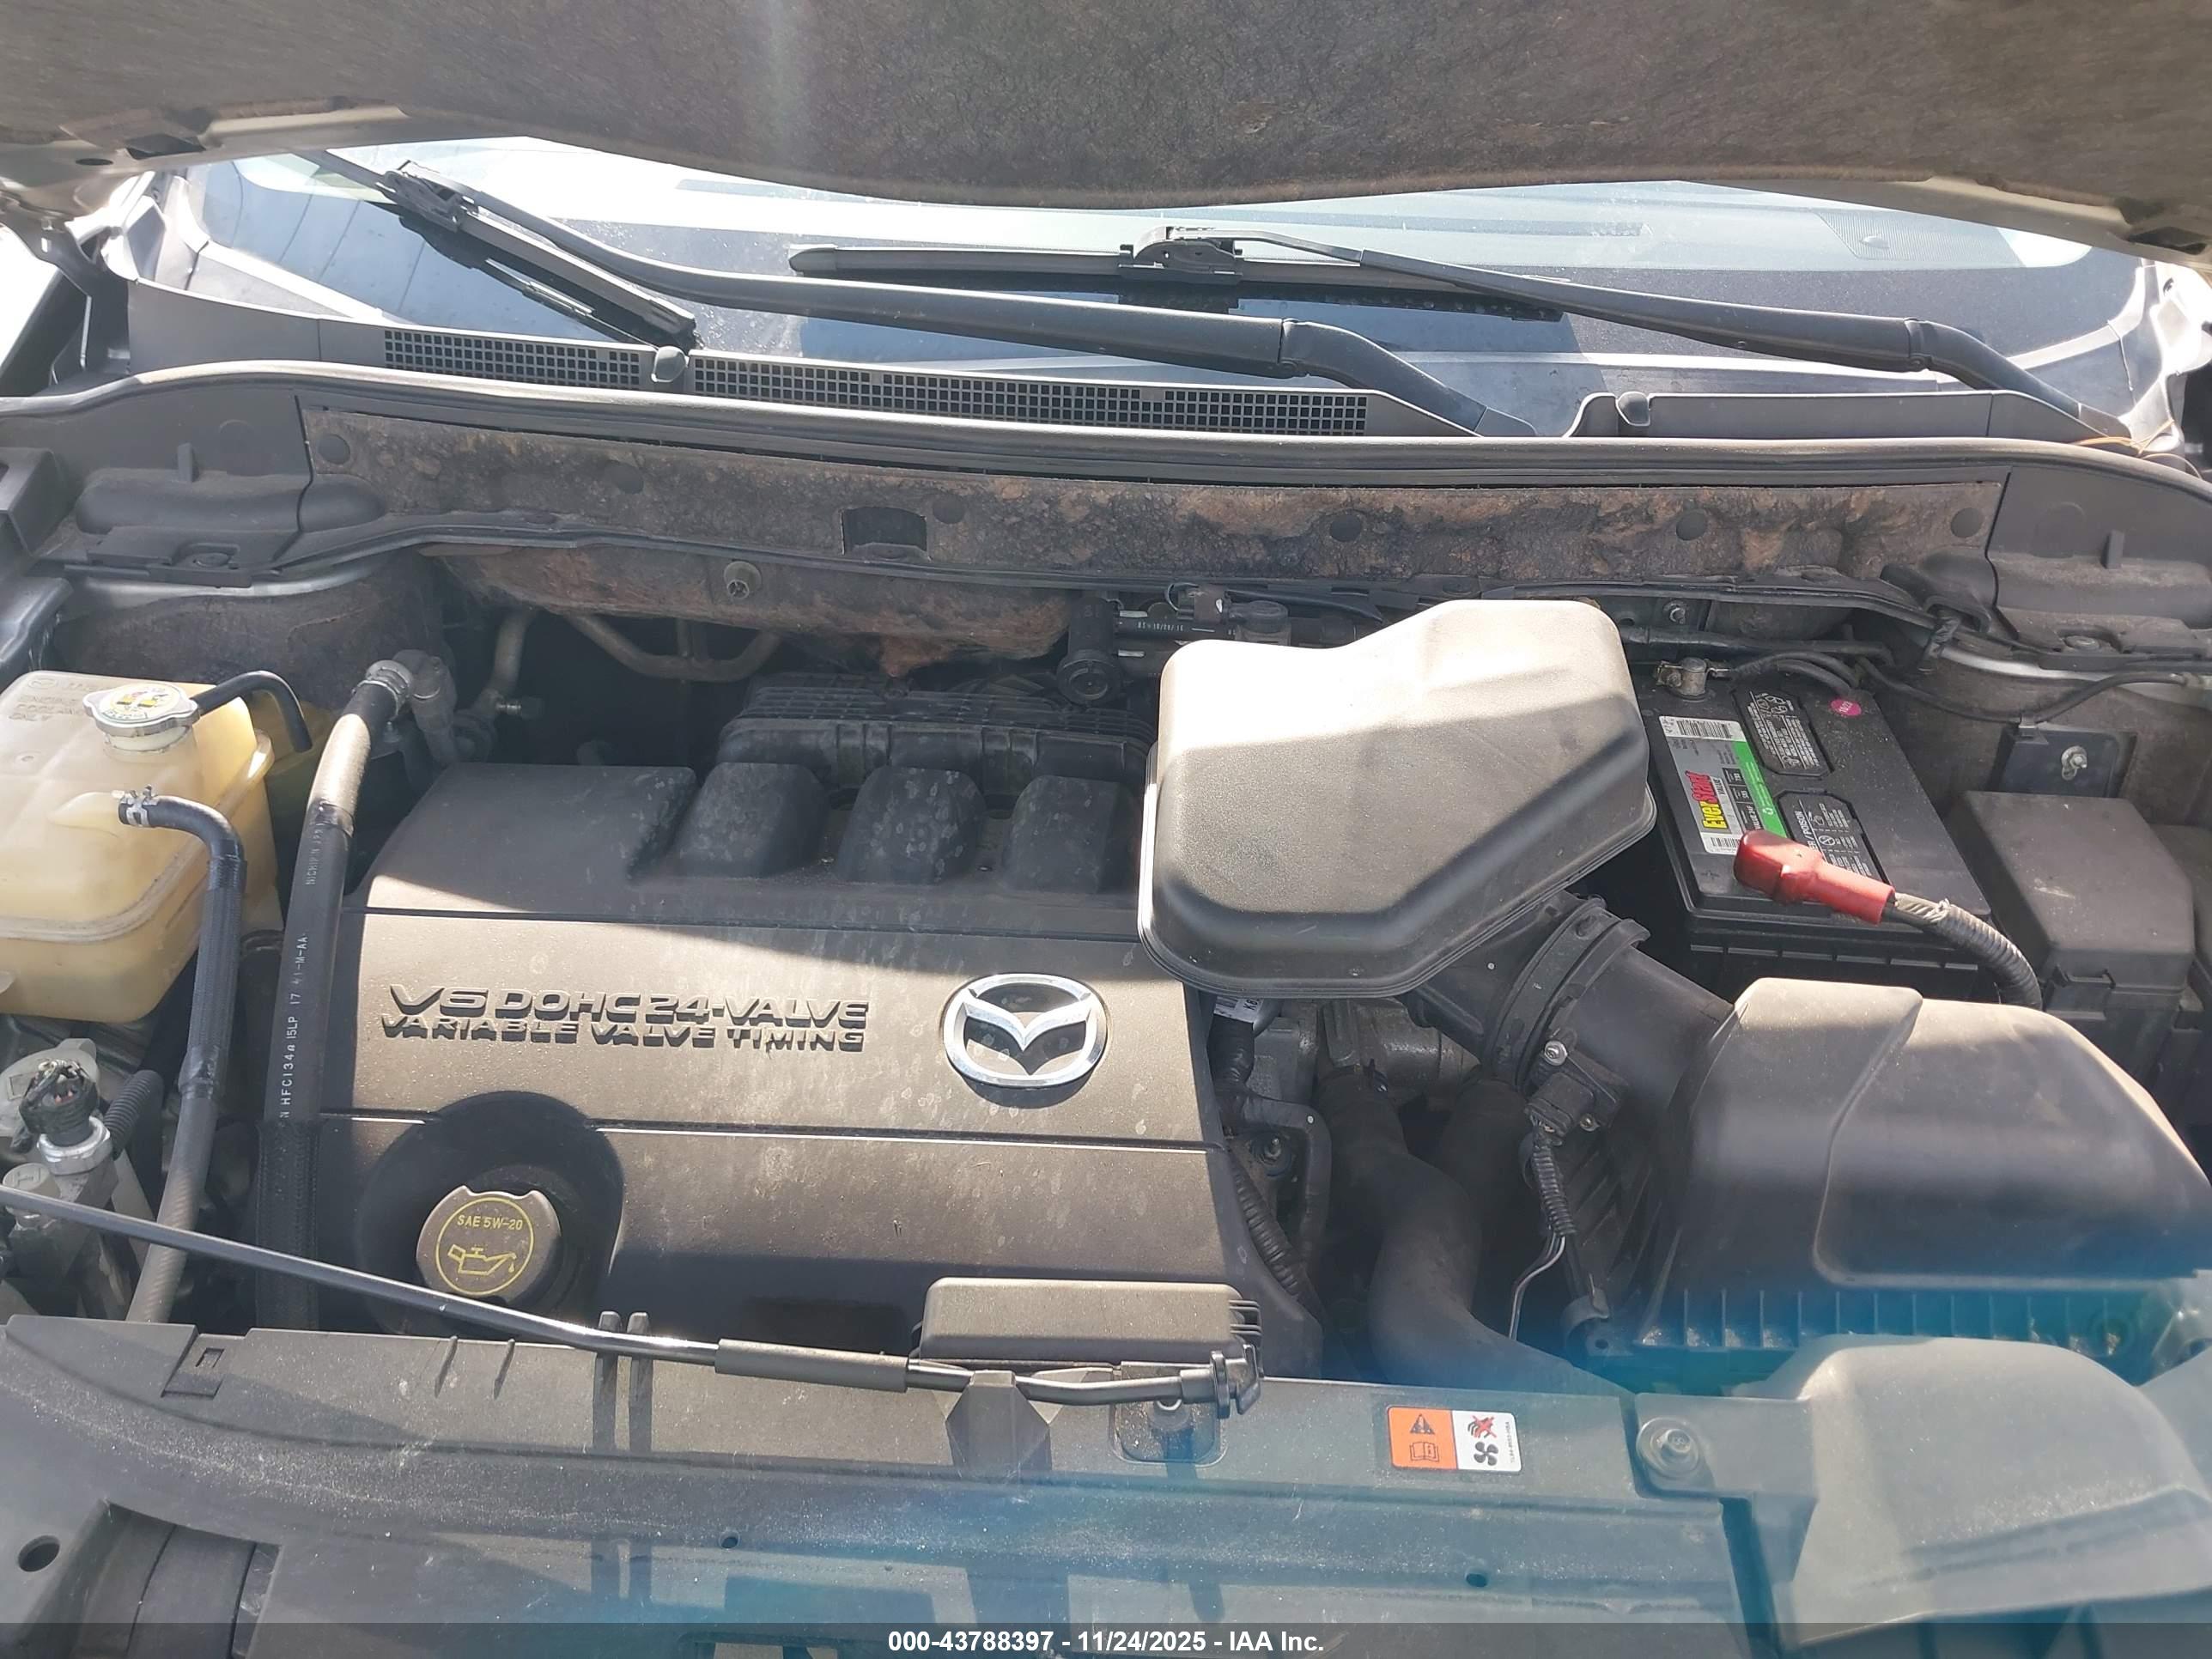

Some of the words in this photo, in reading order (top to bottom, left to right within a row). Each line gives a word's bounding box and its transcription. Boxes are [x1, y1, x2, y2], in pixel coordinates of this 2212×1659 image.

[1685, 770, 1729, 830] EverStart
[1794, 811, 1813, 835] POISON
[389, 983, 489, 1018] V6
[495, 988, 641, 1024] DOHC
[381, 1015, 579, 1045] VARIABLE
[590, 1020, 716, 1048] VALVE
[726, 1026, 865, 1053] TIMING
[456, 1214, 482, 1228] SAE
[483, 1216, 524, 1231] 5W-20
